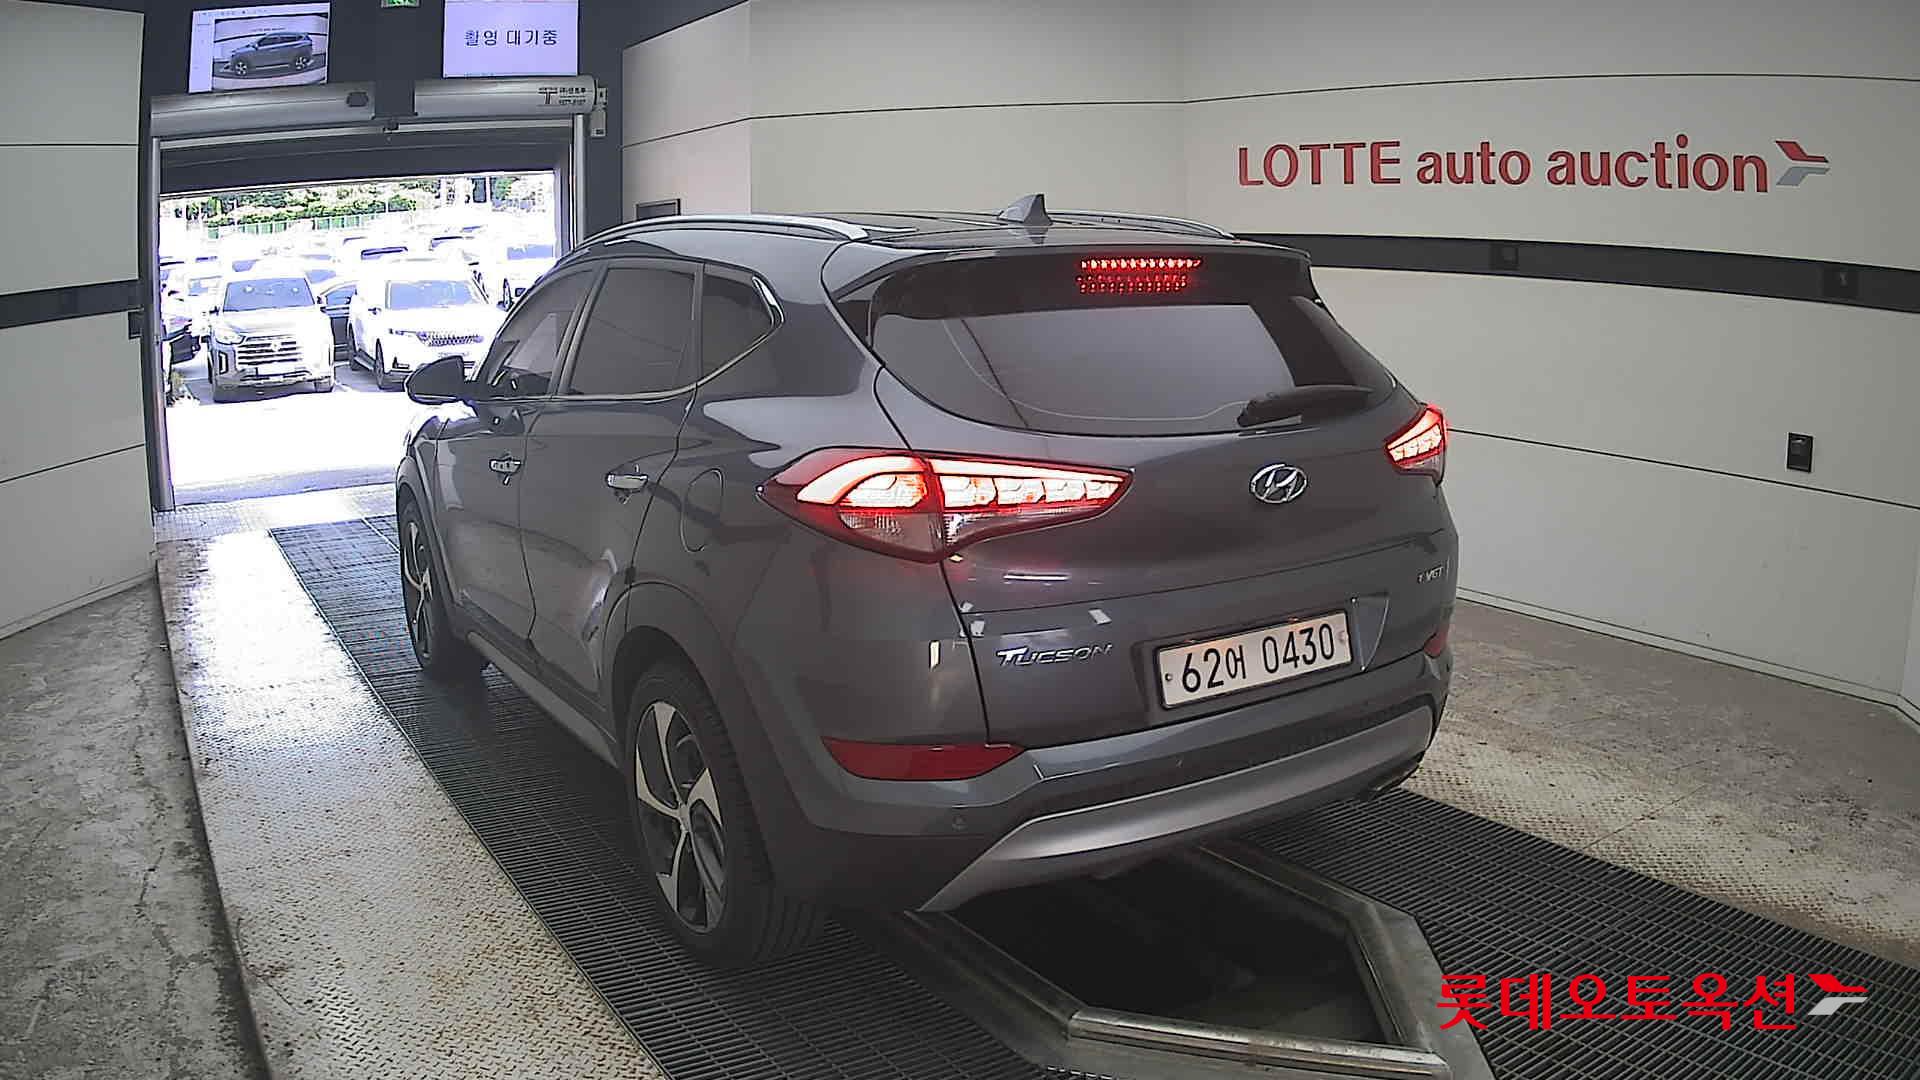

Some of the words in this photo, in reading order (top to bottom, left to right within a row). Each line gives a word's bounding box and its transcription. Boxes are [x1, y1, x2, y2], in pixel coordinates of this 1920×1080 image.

[506, 29, 558, 46] 대기중
[1238, 140, 1400, 187] LOTTE
[1416, 141, 1531, 185] auto
[1546, 134, 1768, 193] auction
[996, 643, 1113, 666] TUCSON
[1182, 645, 1246, 693] 62어
[1262, 623, 1335, 674] 0430
